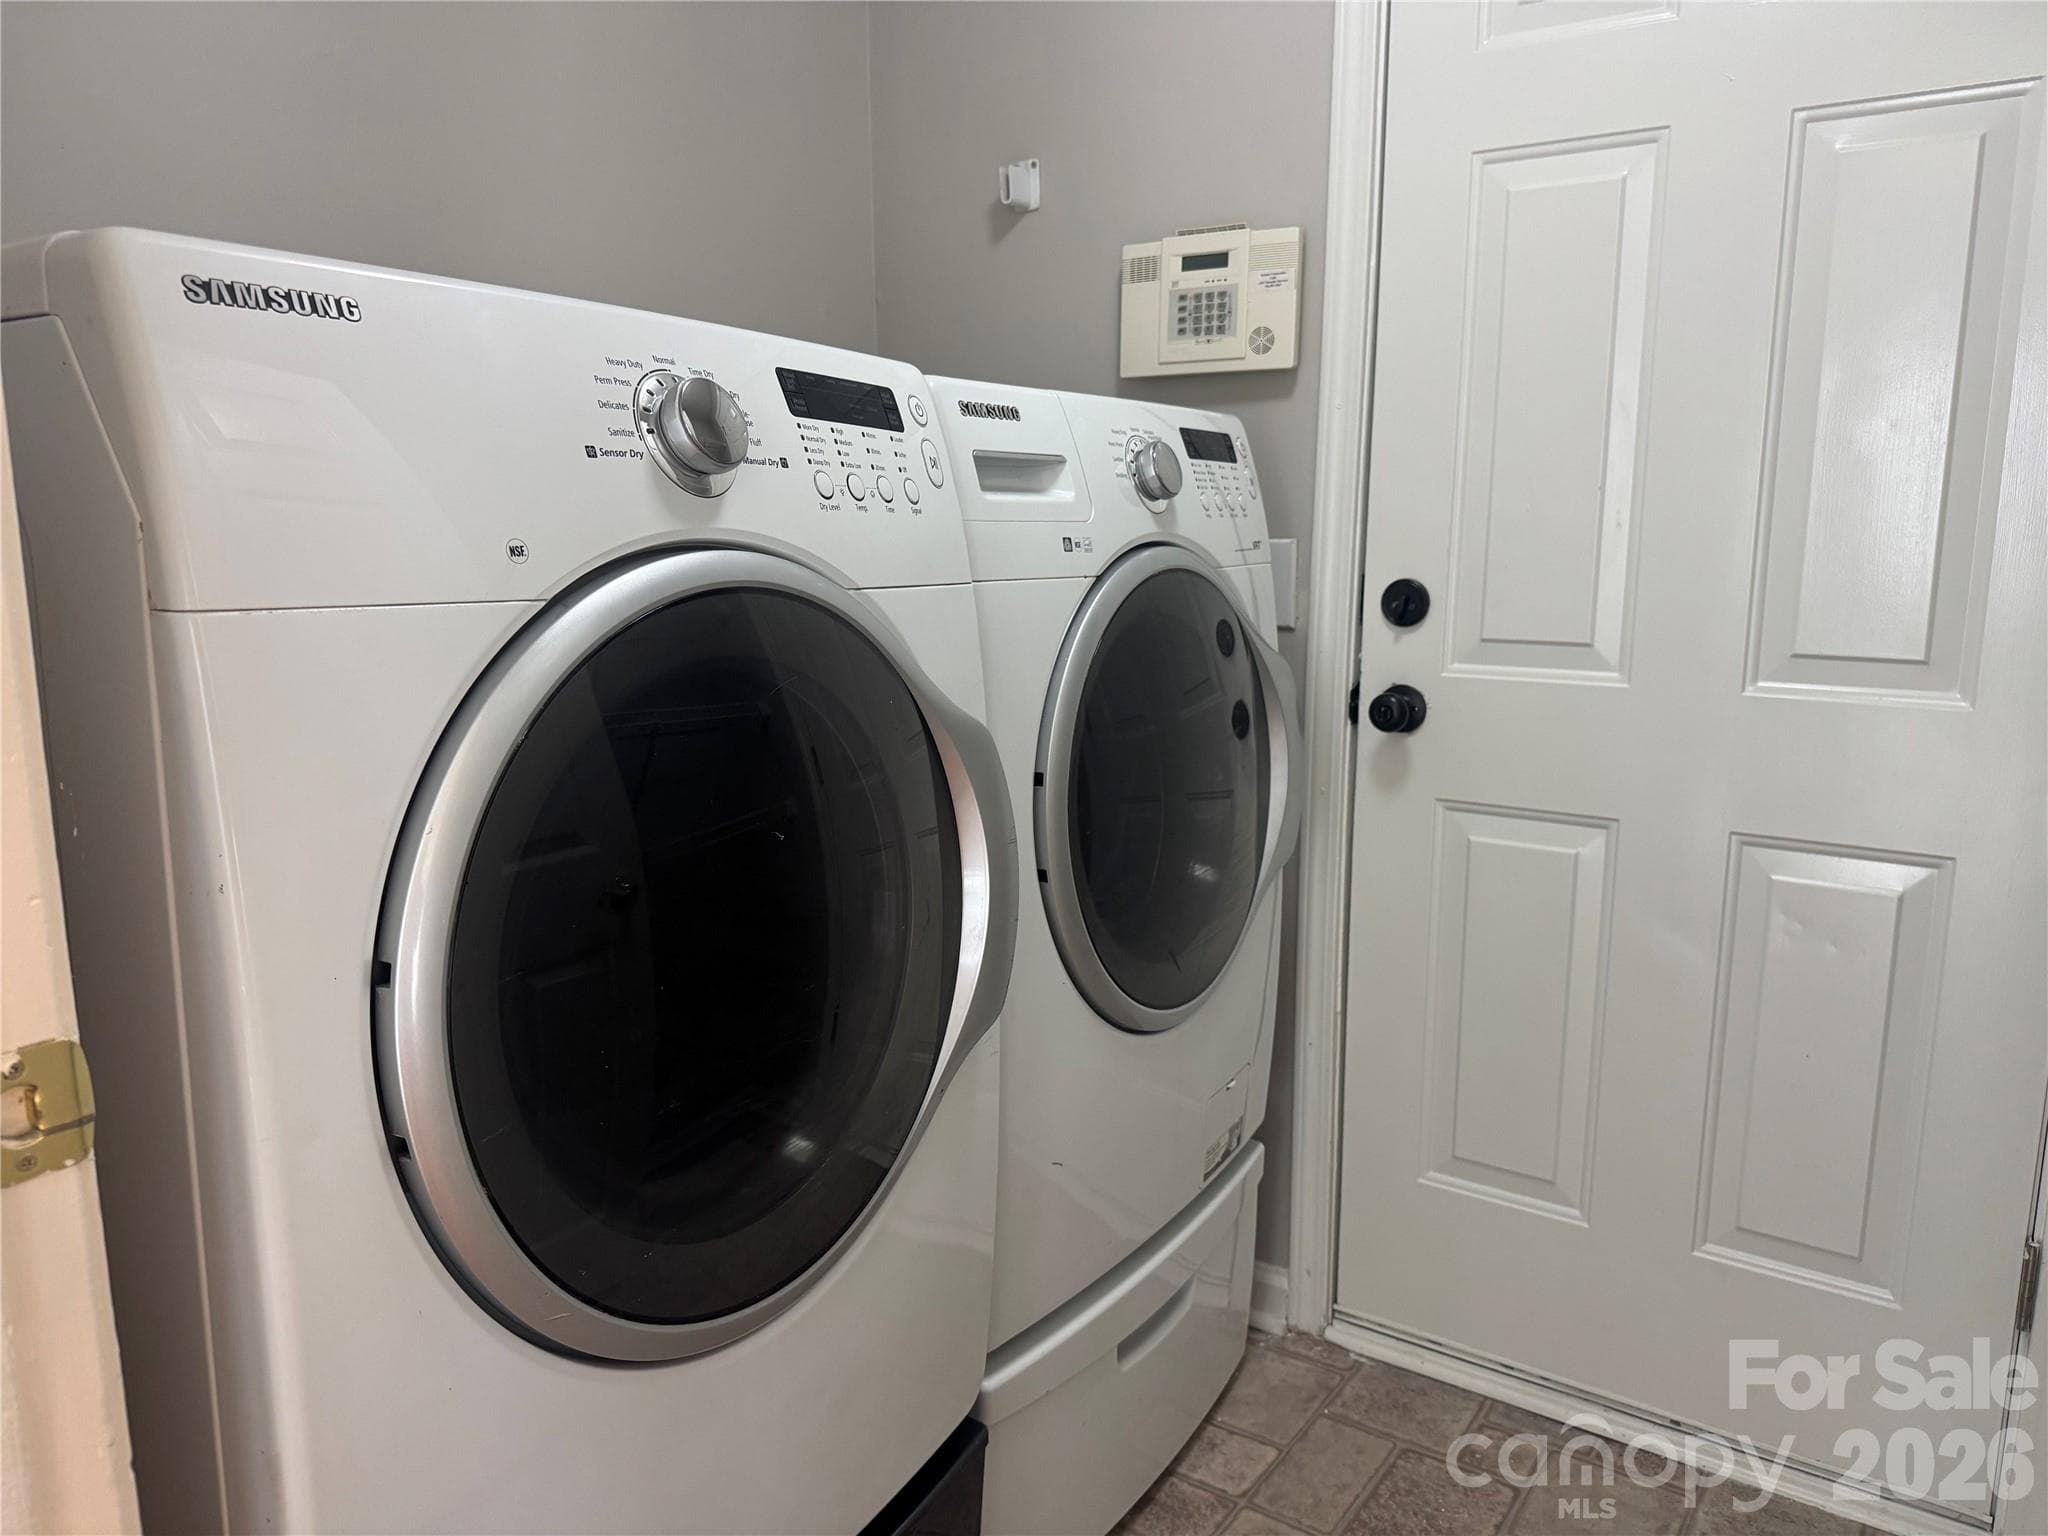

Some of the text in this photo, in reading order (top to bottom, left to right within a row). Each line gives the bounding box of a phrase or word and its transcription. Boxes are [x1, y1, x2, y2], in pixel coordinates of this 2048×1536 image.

[181, 274, 362, 322] SAMSUNG
[605, 356, 643, 371] Heavy Duty
[652, 355, 676, 365] Normal
[688, 367, 714, 380] Time Dry
[594, 375, 632, 387] Perm Press
[598, 400, 629, 411] Delicates
[958, 400, 1021, 422] SAMSUNG
[608, 427, 636, 438] Sanitize
[599, 447, 644, 461] Sensor Dry
[743, 456, 779, 469] Manual Dry
[819, 502, 841, 512] Dry Level
[509, 545, 525, 557] NSF
